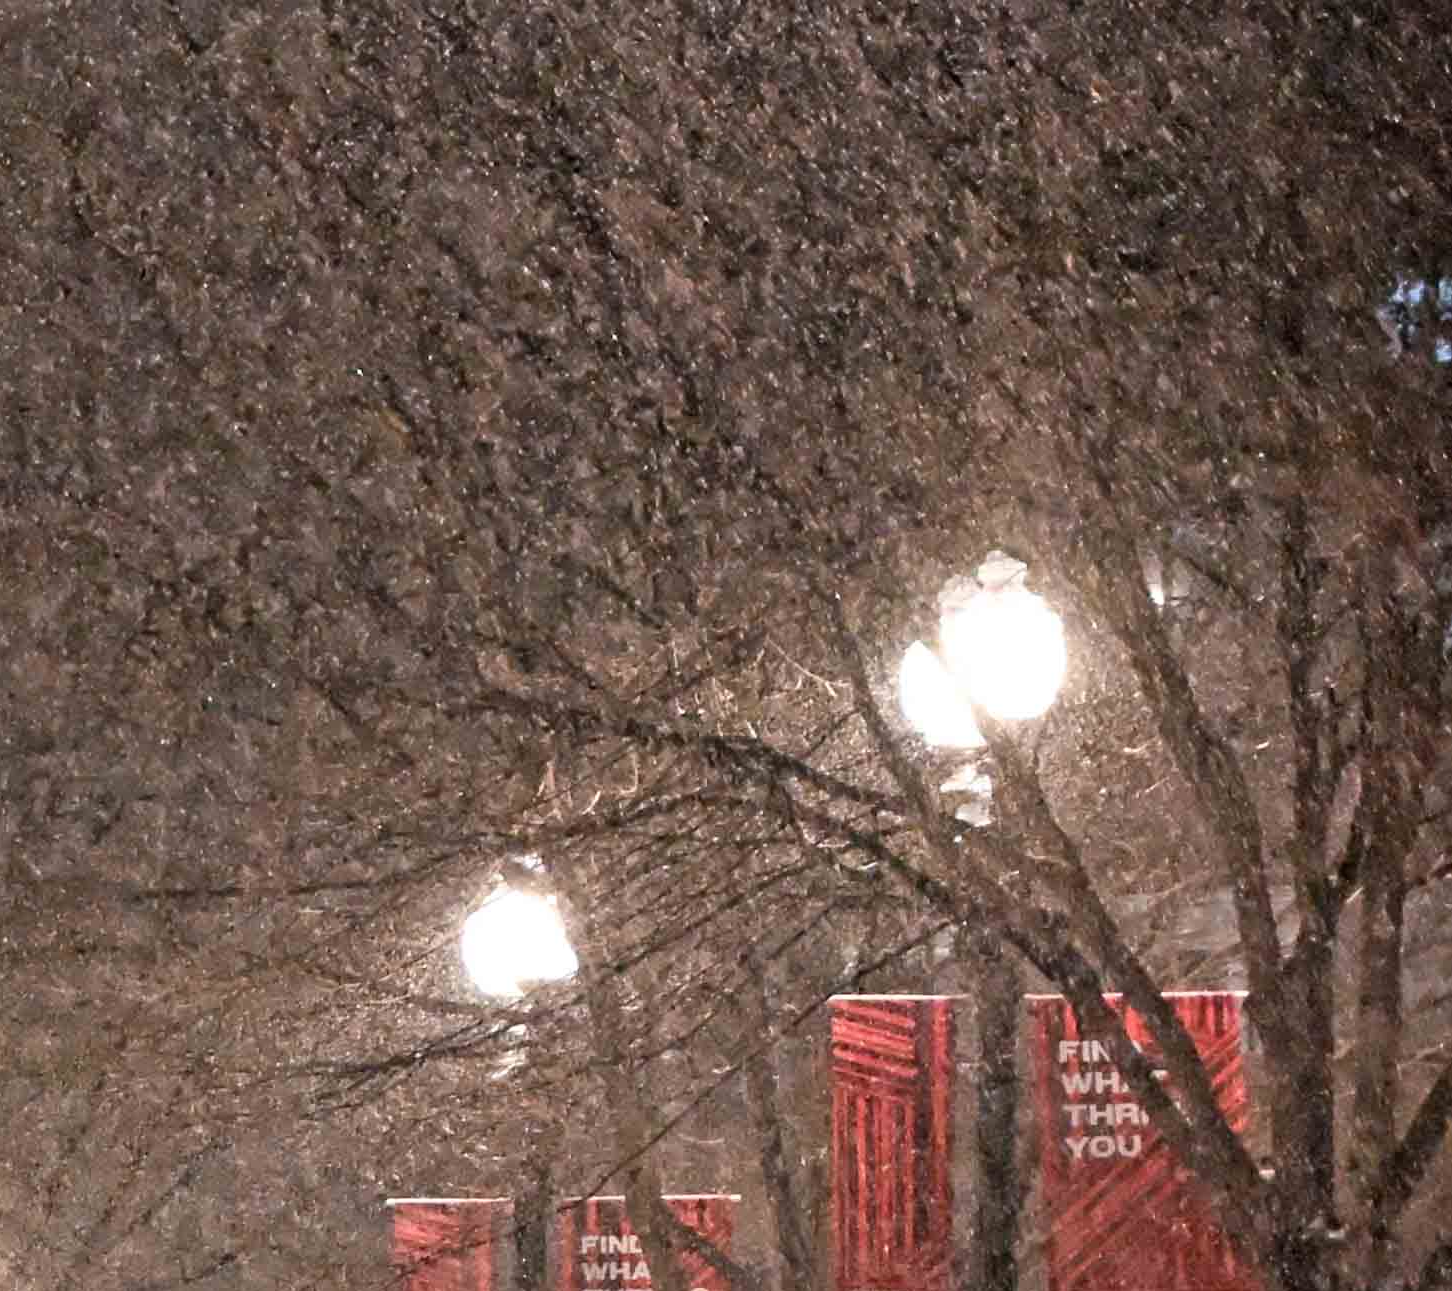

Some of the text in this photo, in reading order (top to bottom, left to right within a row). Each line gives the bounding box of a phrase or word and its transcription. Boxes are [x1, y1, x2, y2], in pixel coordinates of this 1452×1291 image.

[1059, 1040, 1143, 1063] FIN
[1061, 1070, 1169, 1094] WH
[1064, 1135, 1143, 1159] YOU
[581, 1261, 652, 1281] WHA
